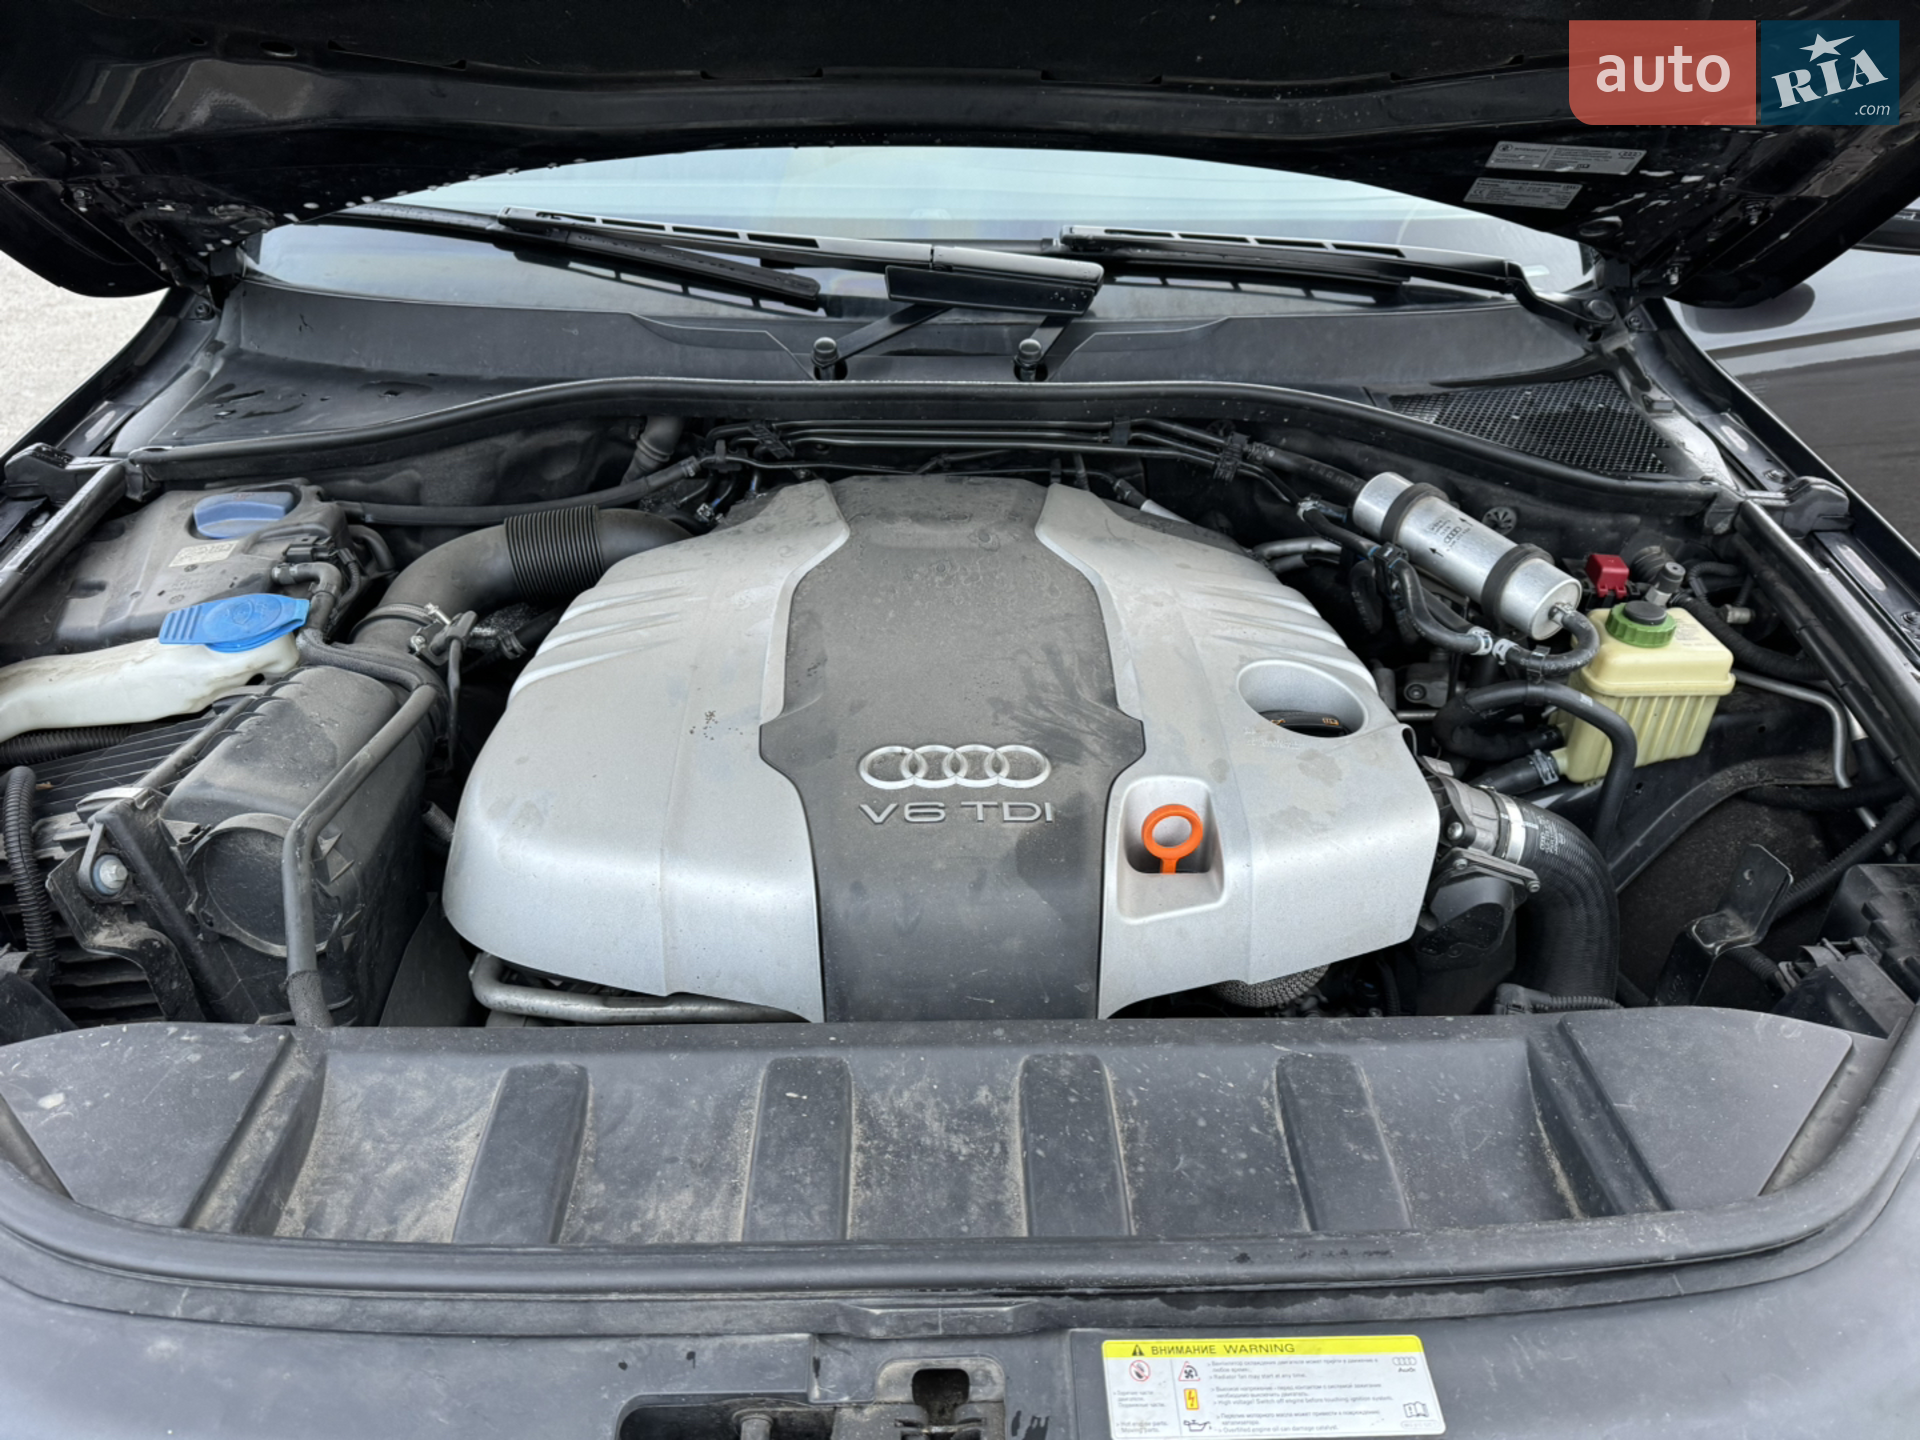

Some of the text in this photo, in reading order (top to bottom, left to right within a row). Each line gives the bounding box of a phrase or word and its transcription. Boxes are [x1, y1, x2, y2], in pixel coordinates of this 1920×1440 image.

[859, 801, 1053, 824] V6 TDI
[1151, 1344, 1217, 1355] ВНИМАНИЕ
[1223, 1343, 1296, 1354] WARNING
